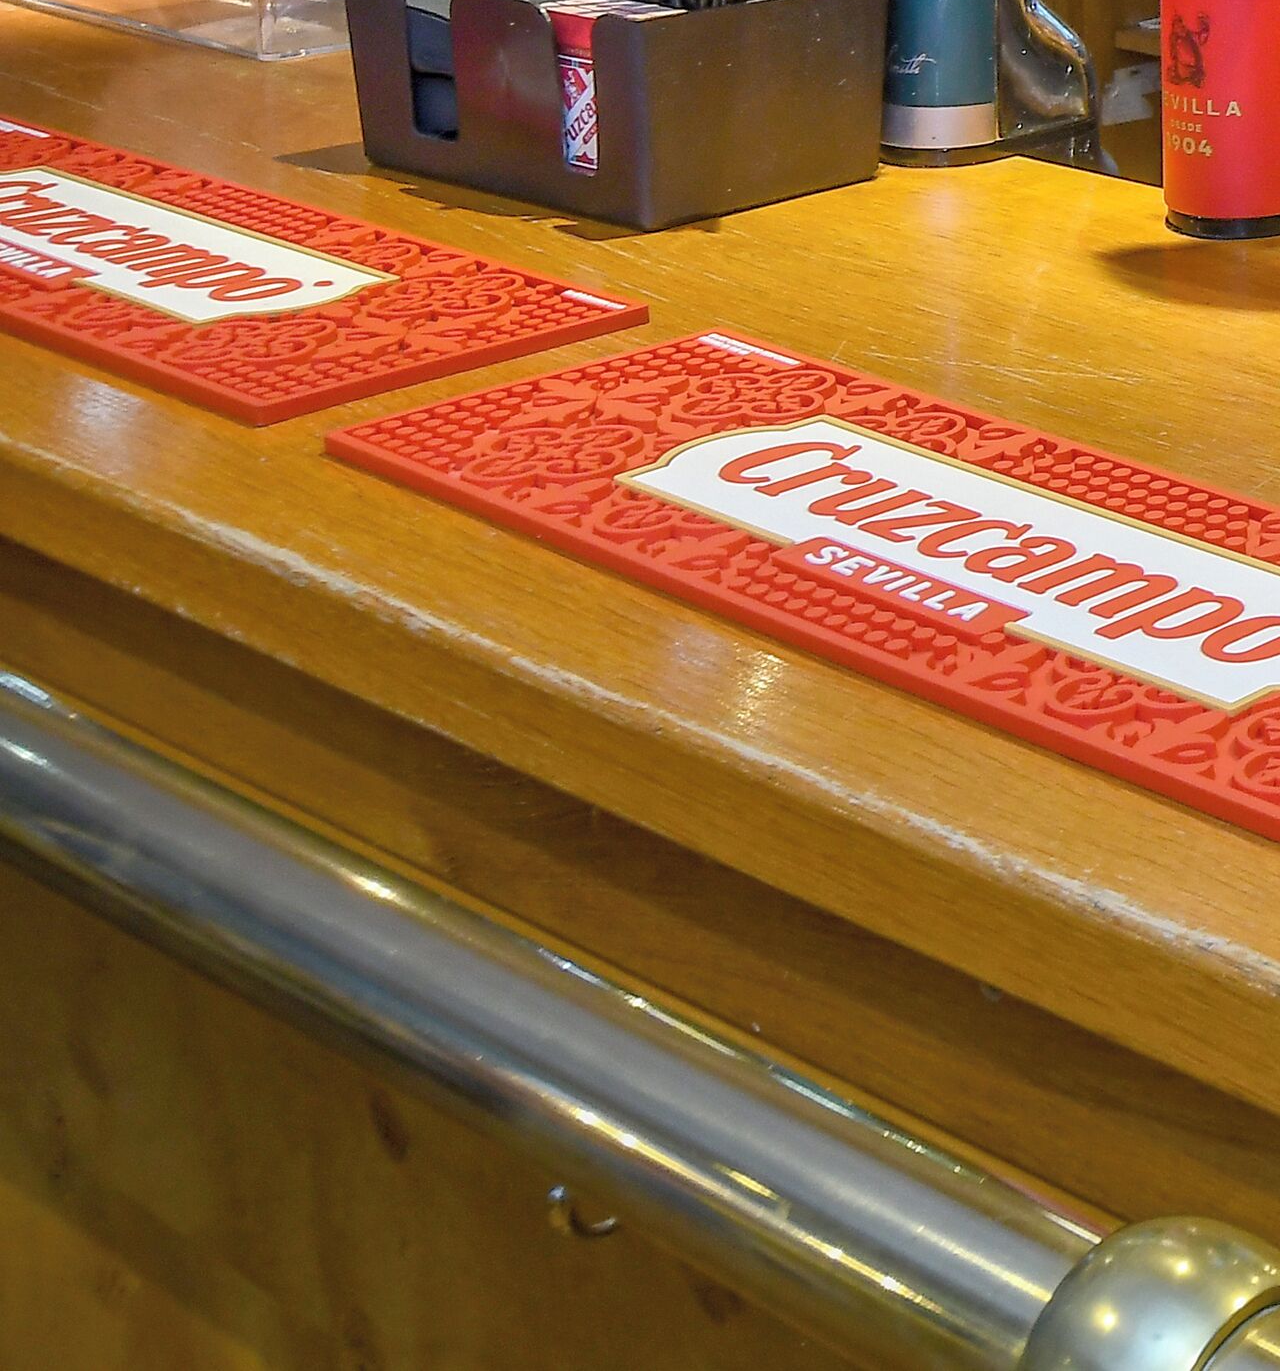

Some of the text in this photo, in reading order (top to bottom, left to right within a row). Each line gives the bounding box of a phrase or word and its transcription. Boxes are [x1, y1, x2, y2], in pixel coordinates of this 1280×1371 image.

[1167, 131, 1213, 157] 1904
[0, 180, 302, 302] Cruzcampo
[0, 243, 72, 277] VILLA
[802, 545, 991, 623] SEVILLA
